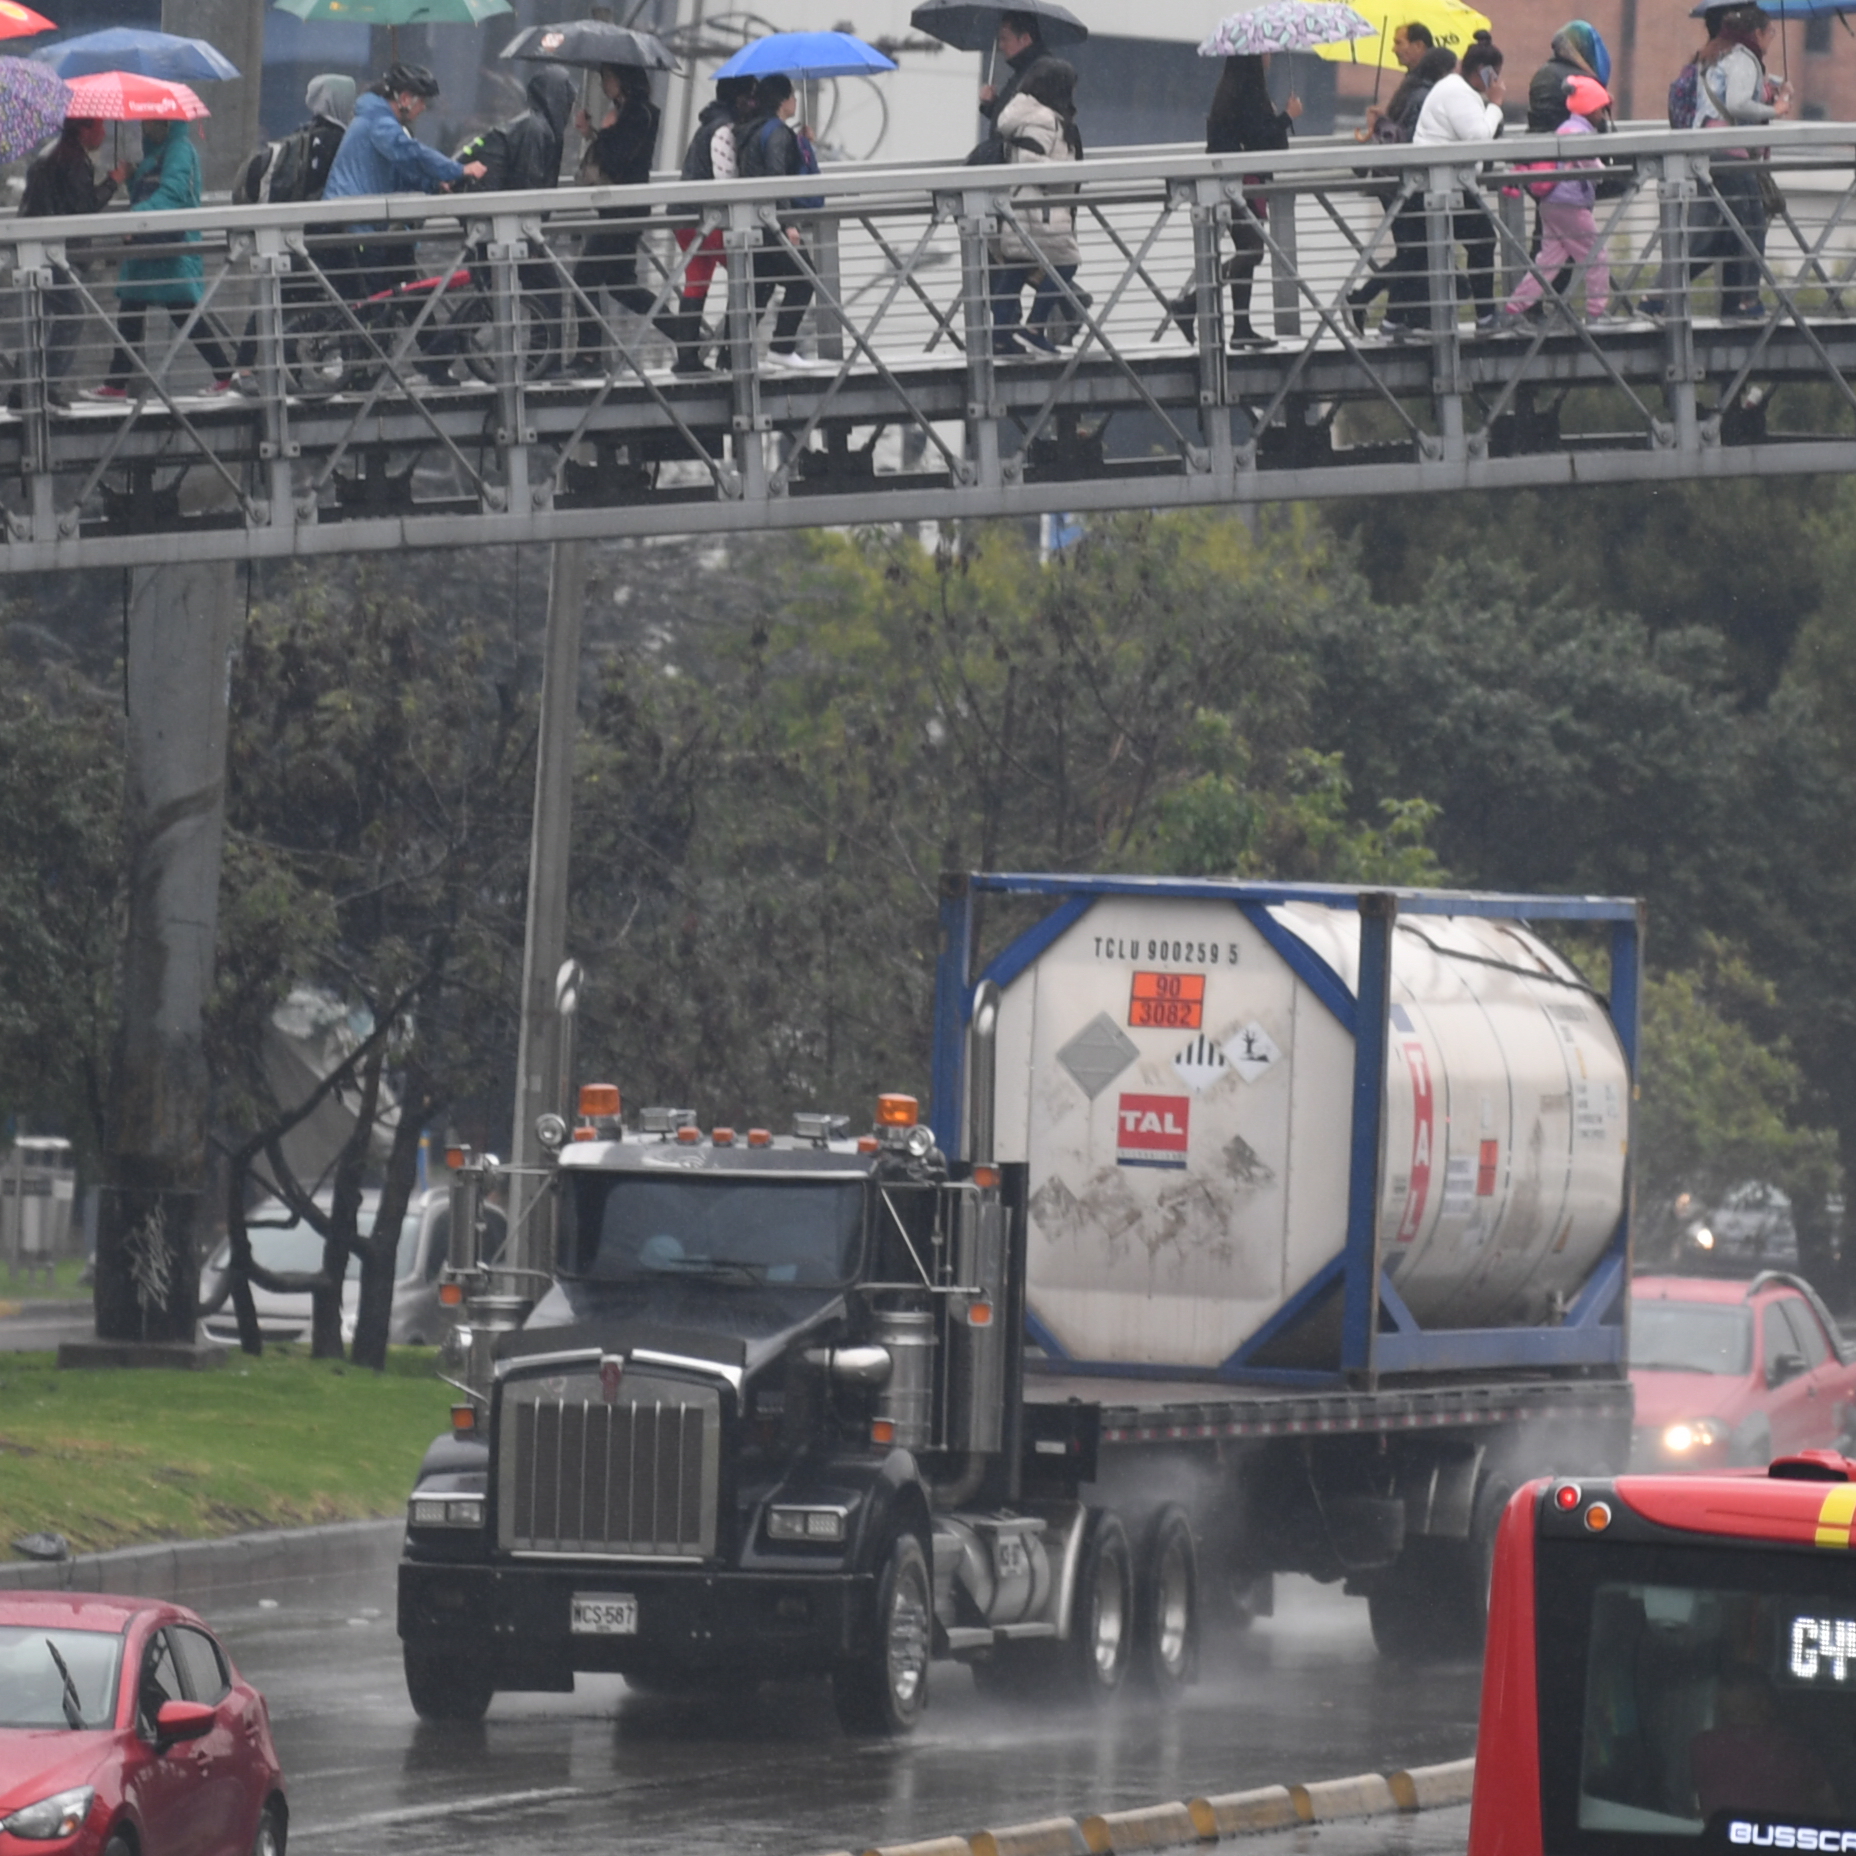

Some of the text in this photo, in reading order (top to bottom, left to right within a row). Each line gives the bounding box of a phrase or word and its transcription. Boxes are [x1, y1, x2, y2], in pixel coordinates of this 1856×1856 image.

[1095, 937, 1239, 965] TCLU 900259 5
[1156, 974, 1181, 998] 90
[1139, 1000, 1192, 1025] 3082
[1120, 1109, 1183, 1134] TAL
